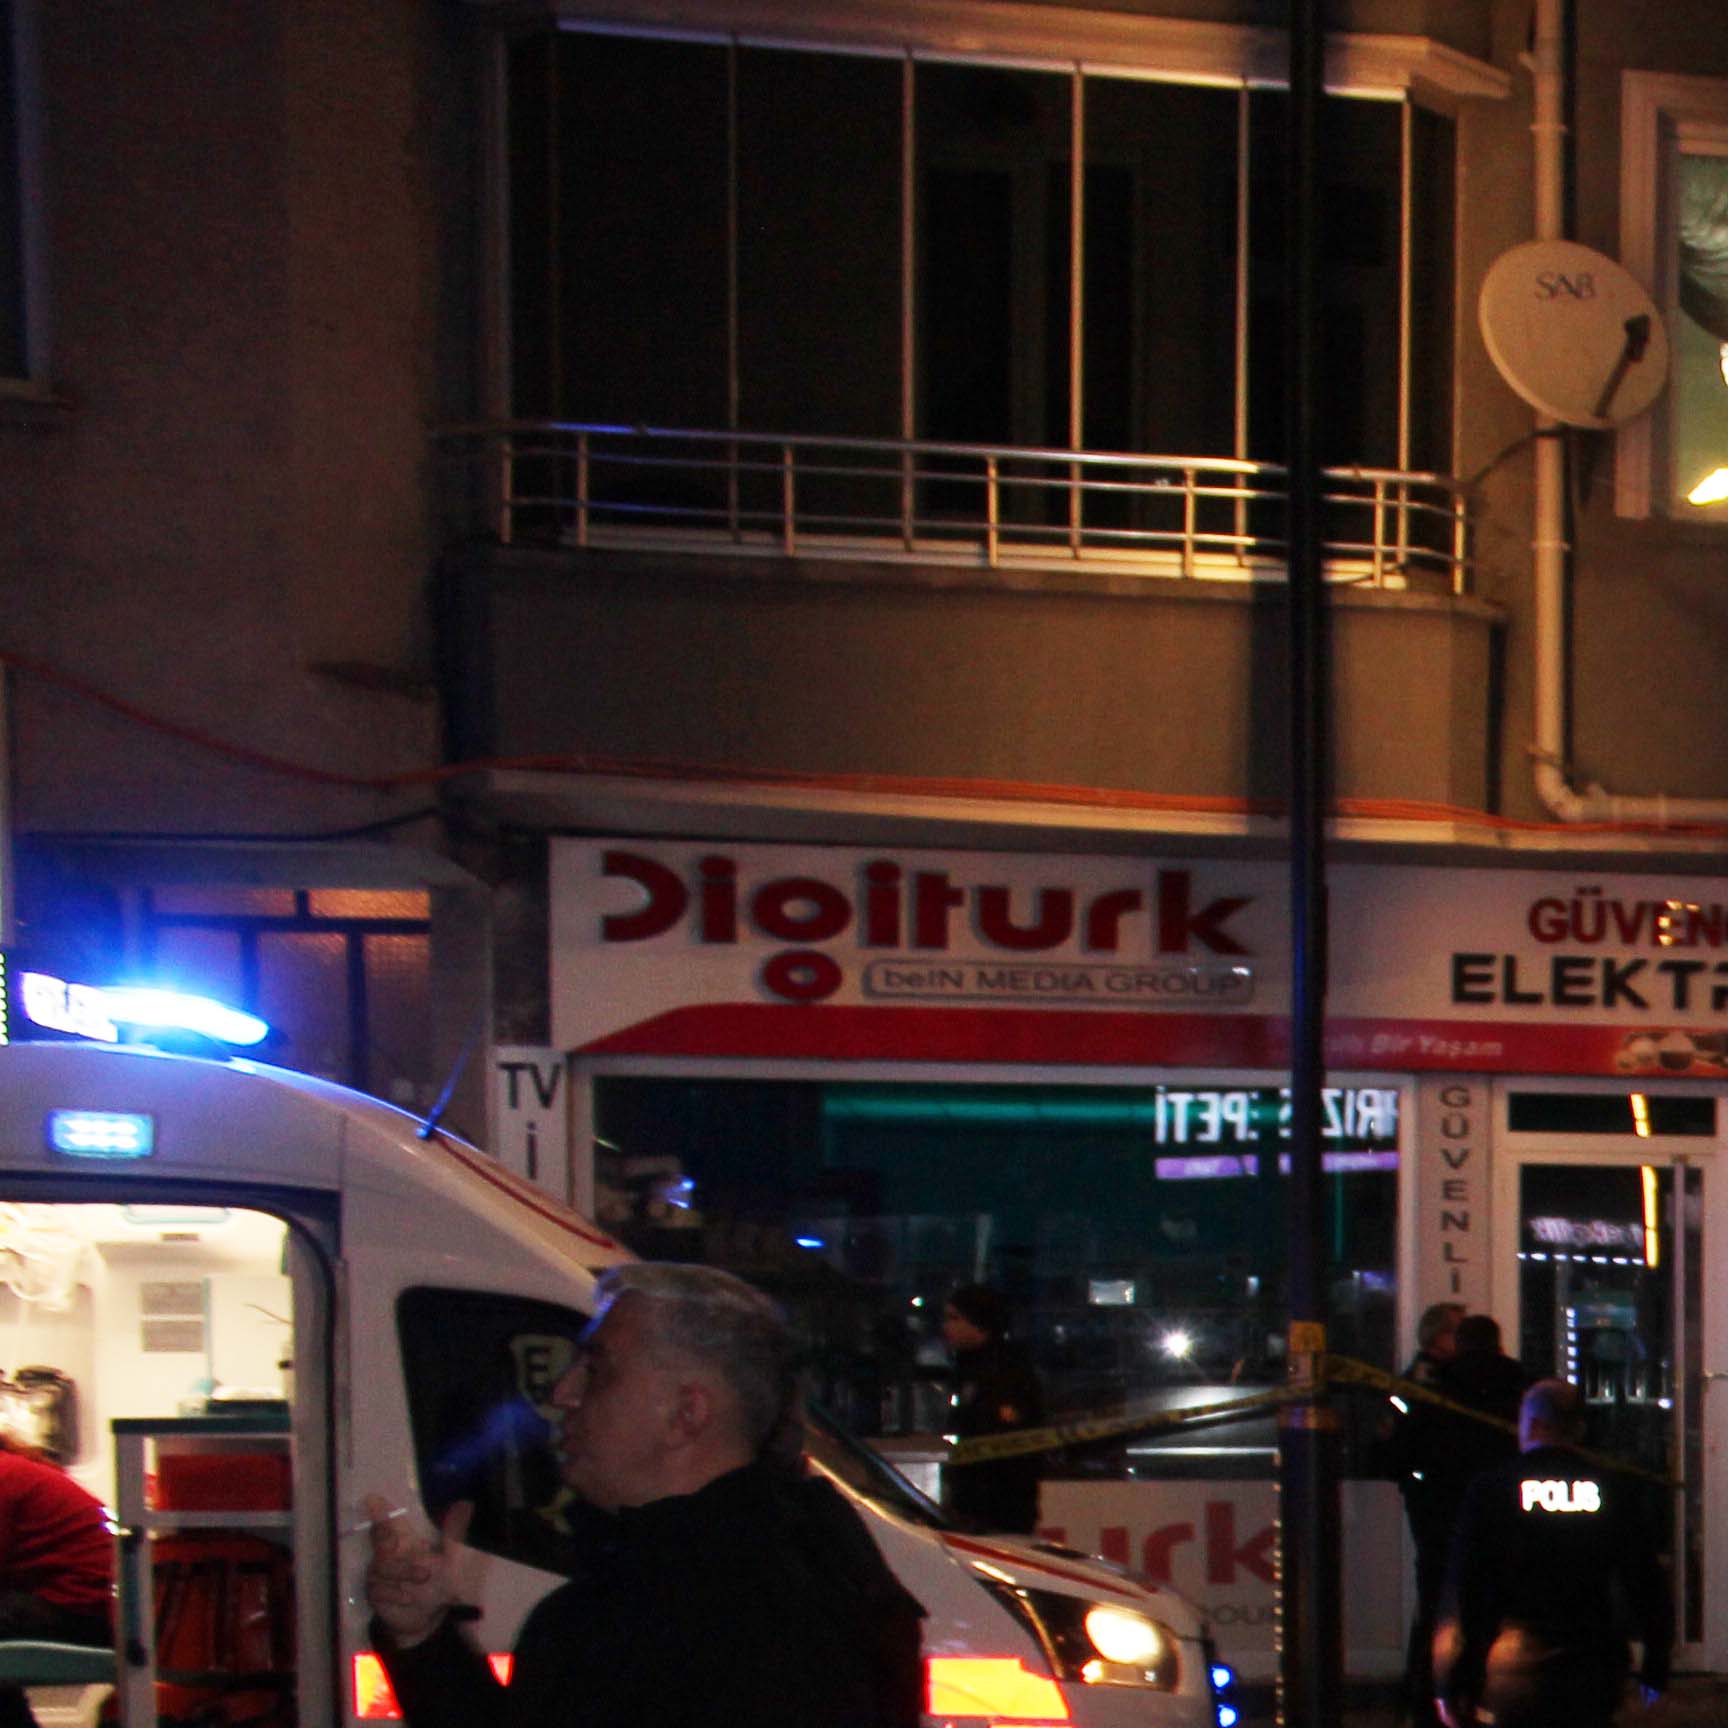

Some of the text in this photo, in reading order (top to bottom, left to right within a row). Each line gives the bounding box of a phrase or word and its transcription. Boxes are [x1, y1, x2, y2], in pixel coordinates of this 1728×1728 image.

[882, 964, 1244, 998] beIN MEDIA GROUP
[495, 1062, 562, 1109] TV
